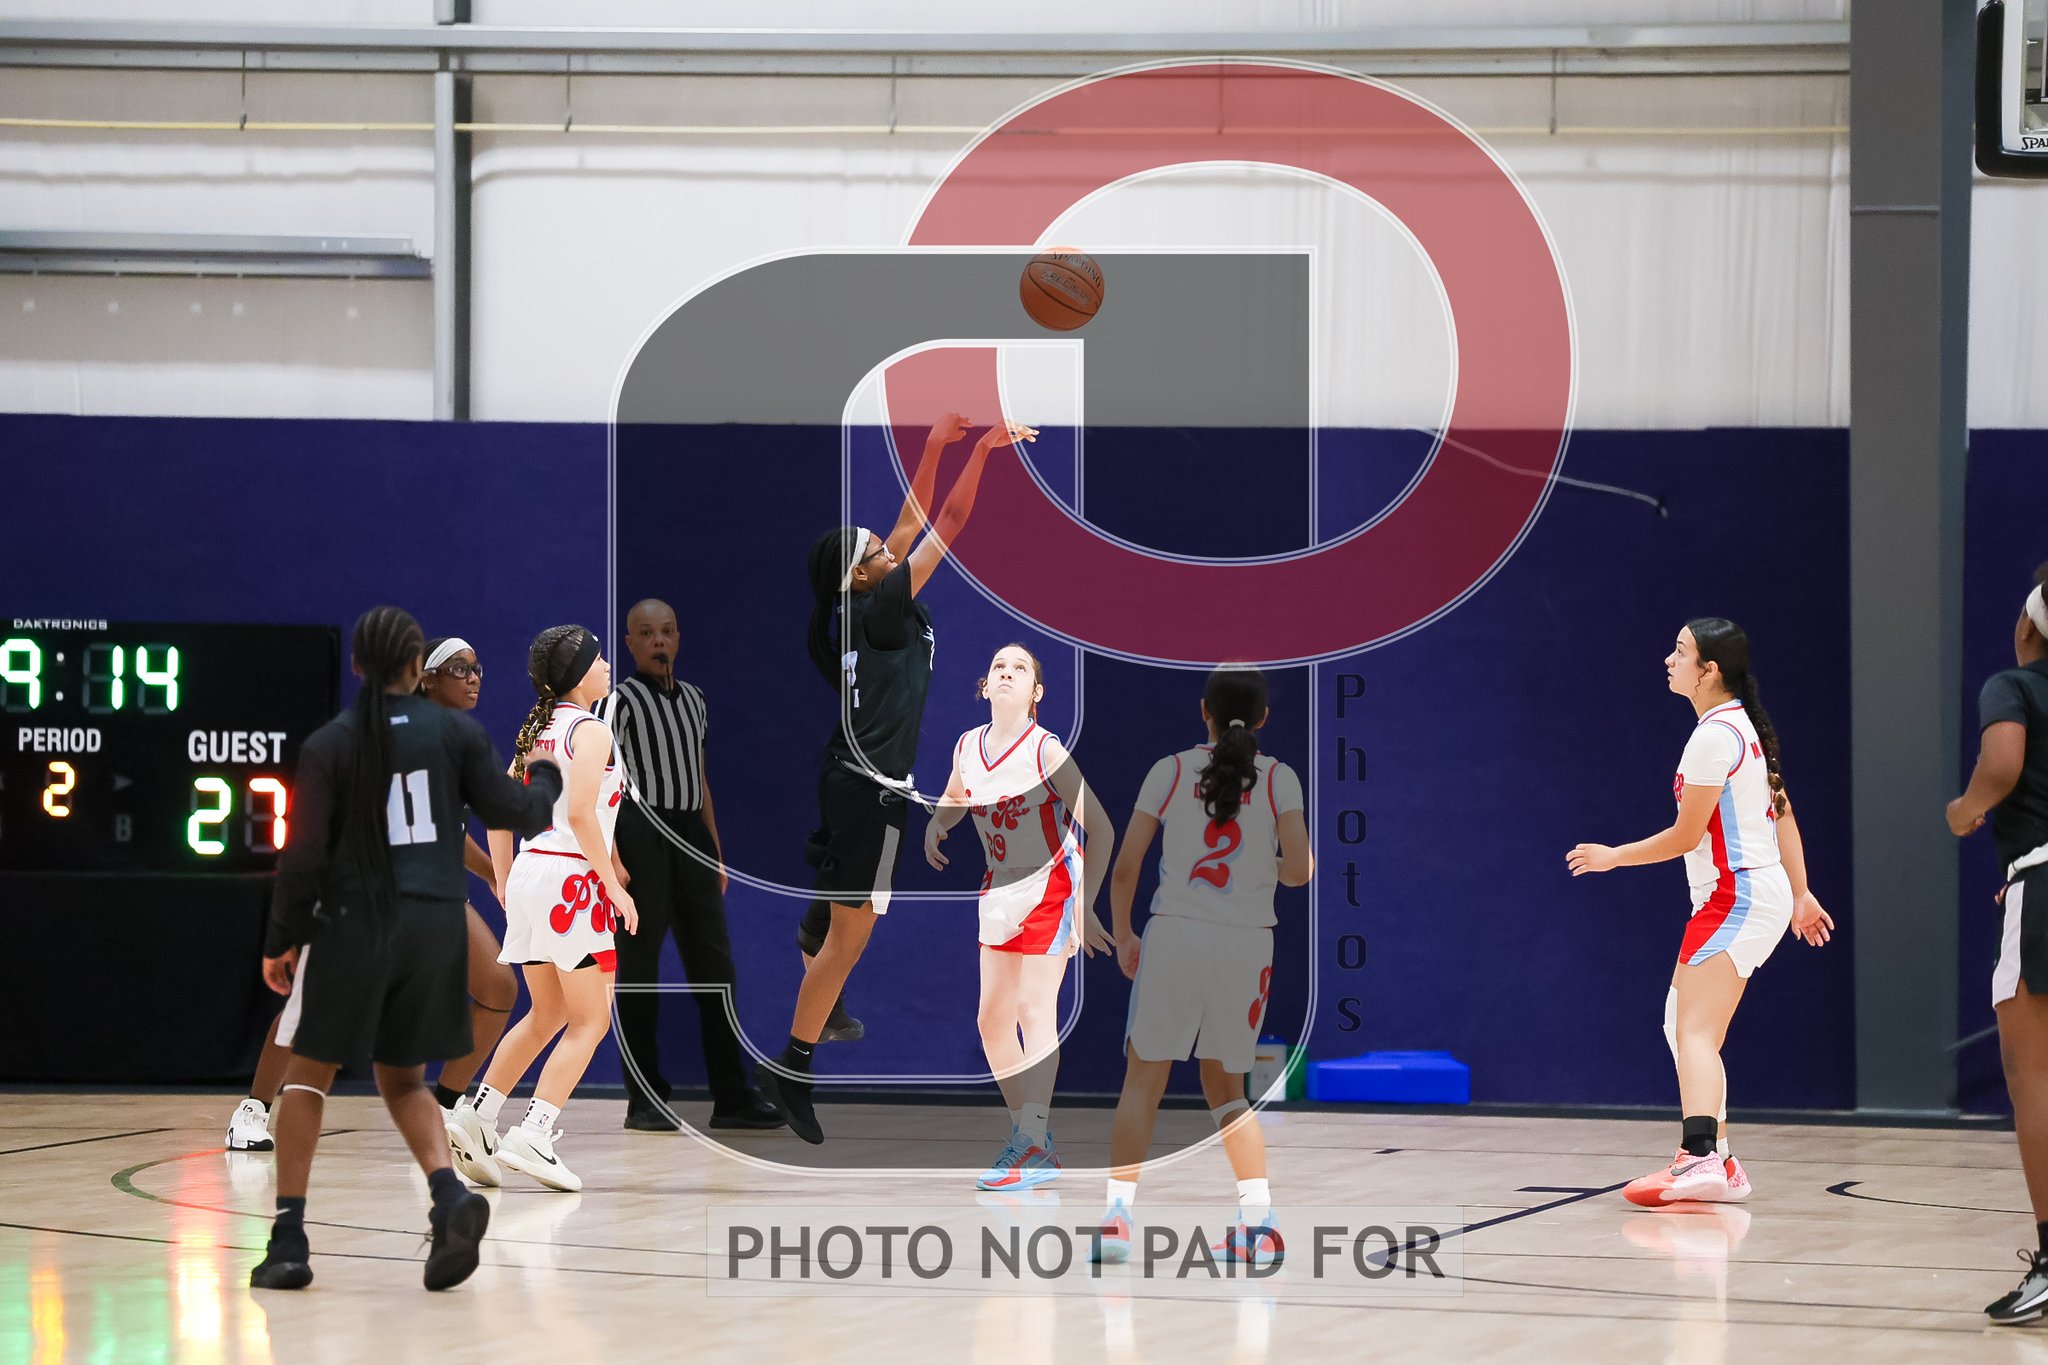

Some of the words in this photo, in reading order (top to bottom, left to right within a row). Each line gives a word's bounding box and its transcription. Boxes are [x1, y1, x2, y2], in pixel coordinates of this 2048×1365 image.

[13, 618, 108, 631] DAKTRONICS
[18, 727, 102, 753] PERIOD
[187, 730, 287, 764] GUEST
[43, 761, 75, 817] 2
[187, 777, 287, 855] 27
[1188, 816, 1243, 892] 2
